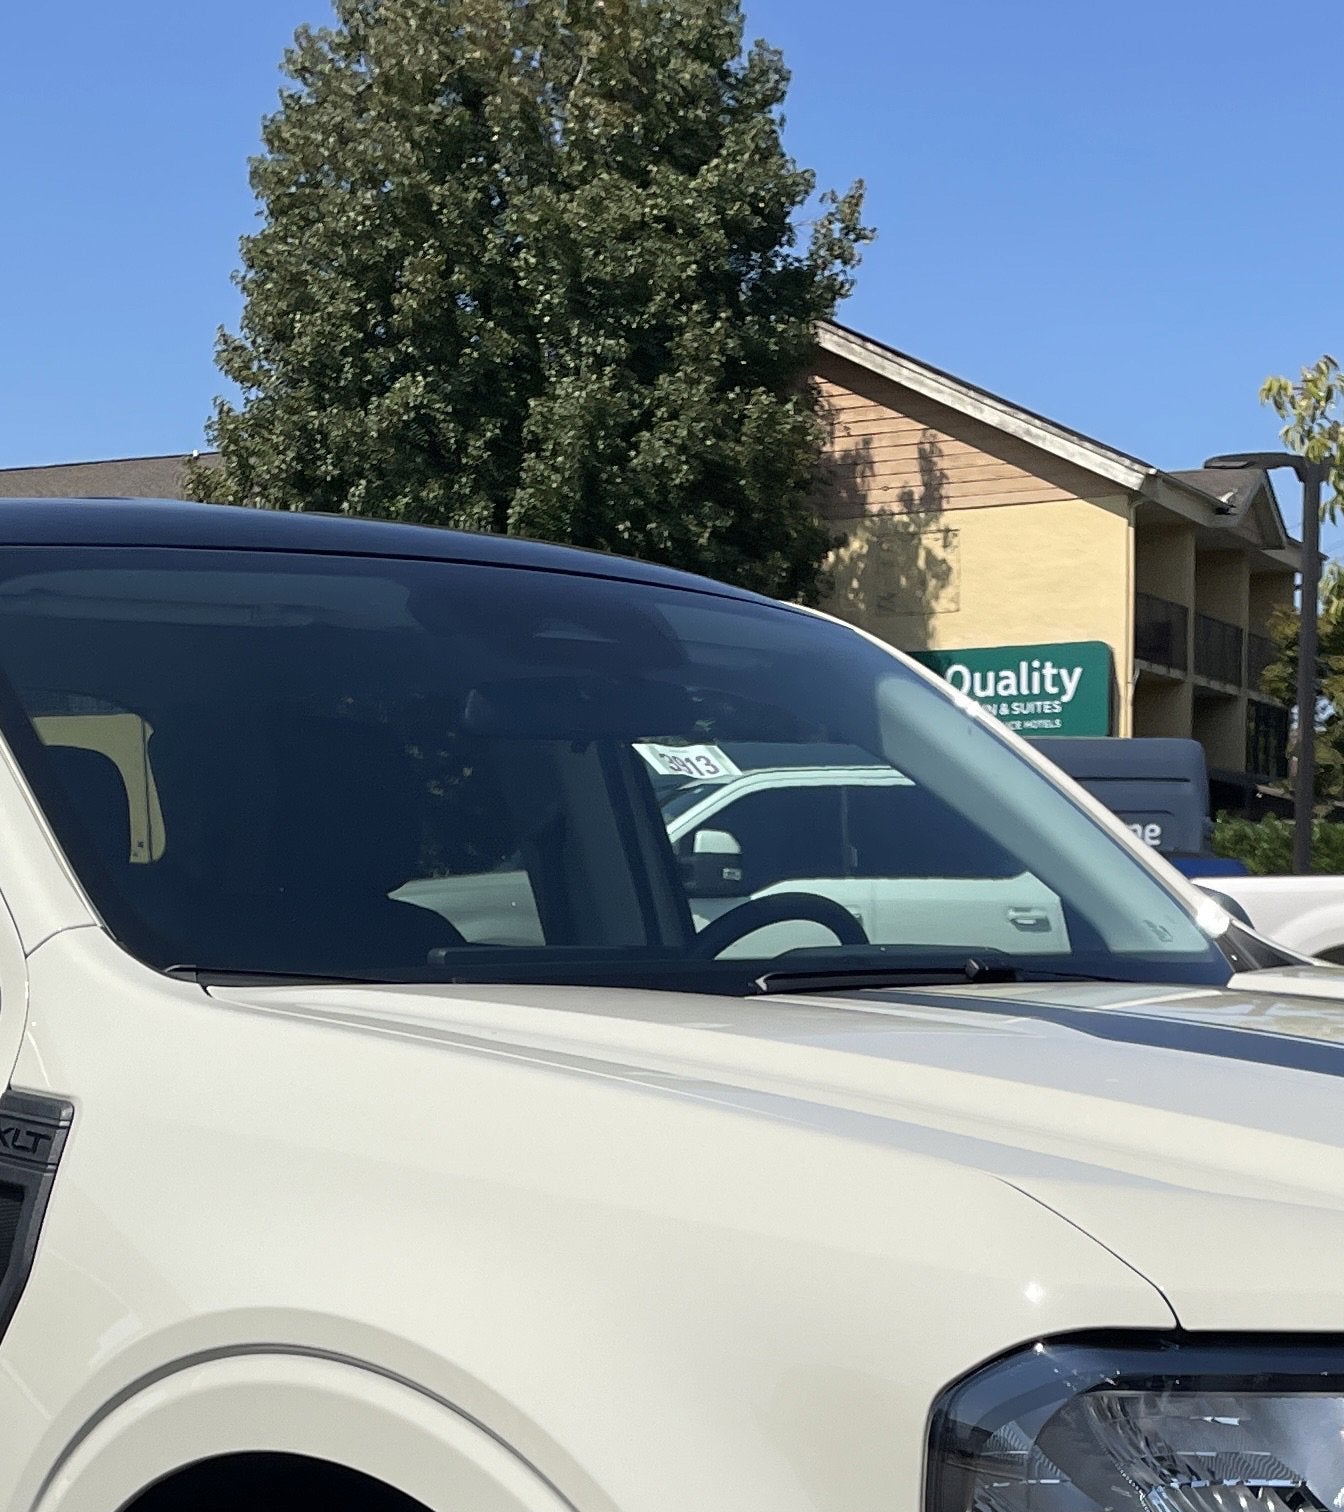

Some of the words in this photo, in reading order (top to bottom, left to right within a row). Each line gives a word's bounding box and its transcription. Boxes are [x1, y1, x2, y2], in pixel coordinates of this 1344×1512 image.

[945, 659, 1083, 702] Quality
[1011, 700, 1063, 715] SUITES
[659, 753, 720, 776] 3913
